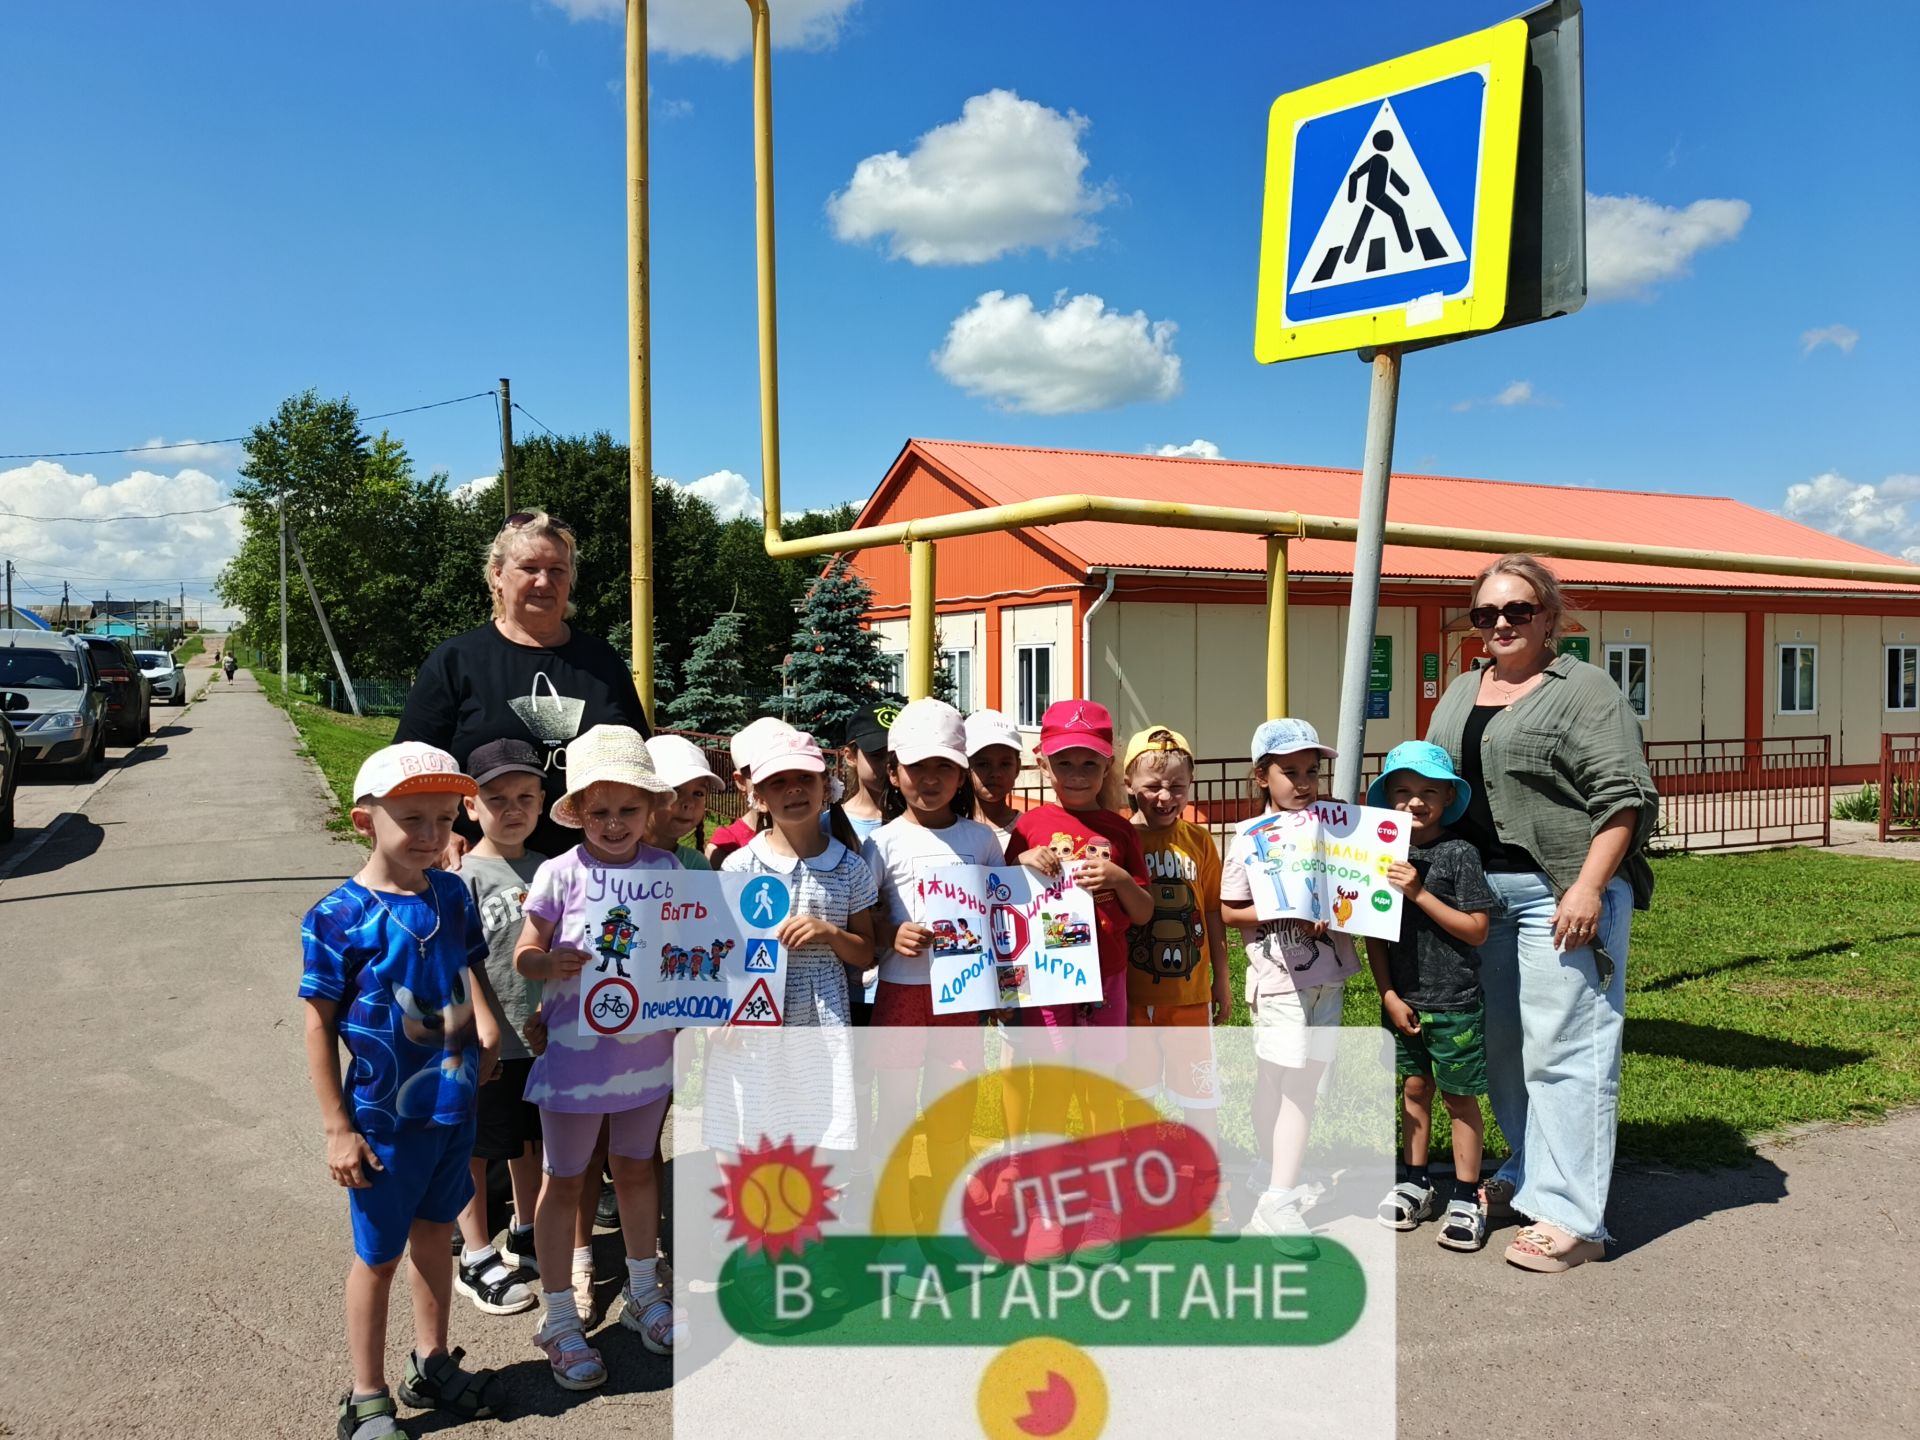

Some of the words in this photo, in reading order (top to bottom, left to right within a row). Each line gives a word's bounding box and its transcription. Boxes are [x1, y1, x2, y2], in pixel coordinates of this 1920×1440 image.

[1288, 805, 1348, 827] ЗНАЙ
[1377, 827, 1398, 836] СТОЙ
[586, 869, 674, 905] Учись
[928, 873, 987, 915] ЖИЗНЬ
[996, 931, 1011, 946] НЕ
[939, 947, 996, 1004] ДОРОГА
[1034, 951, 1087, 986] ИГРА
